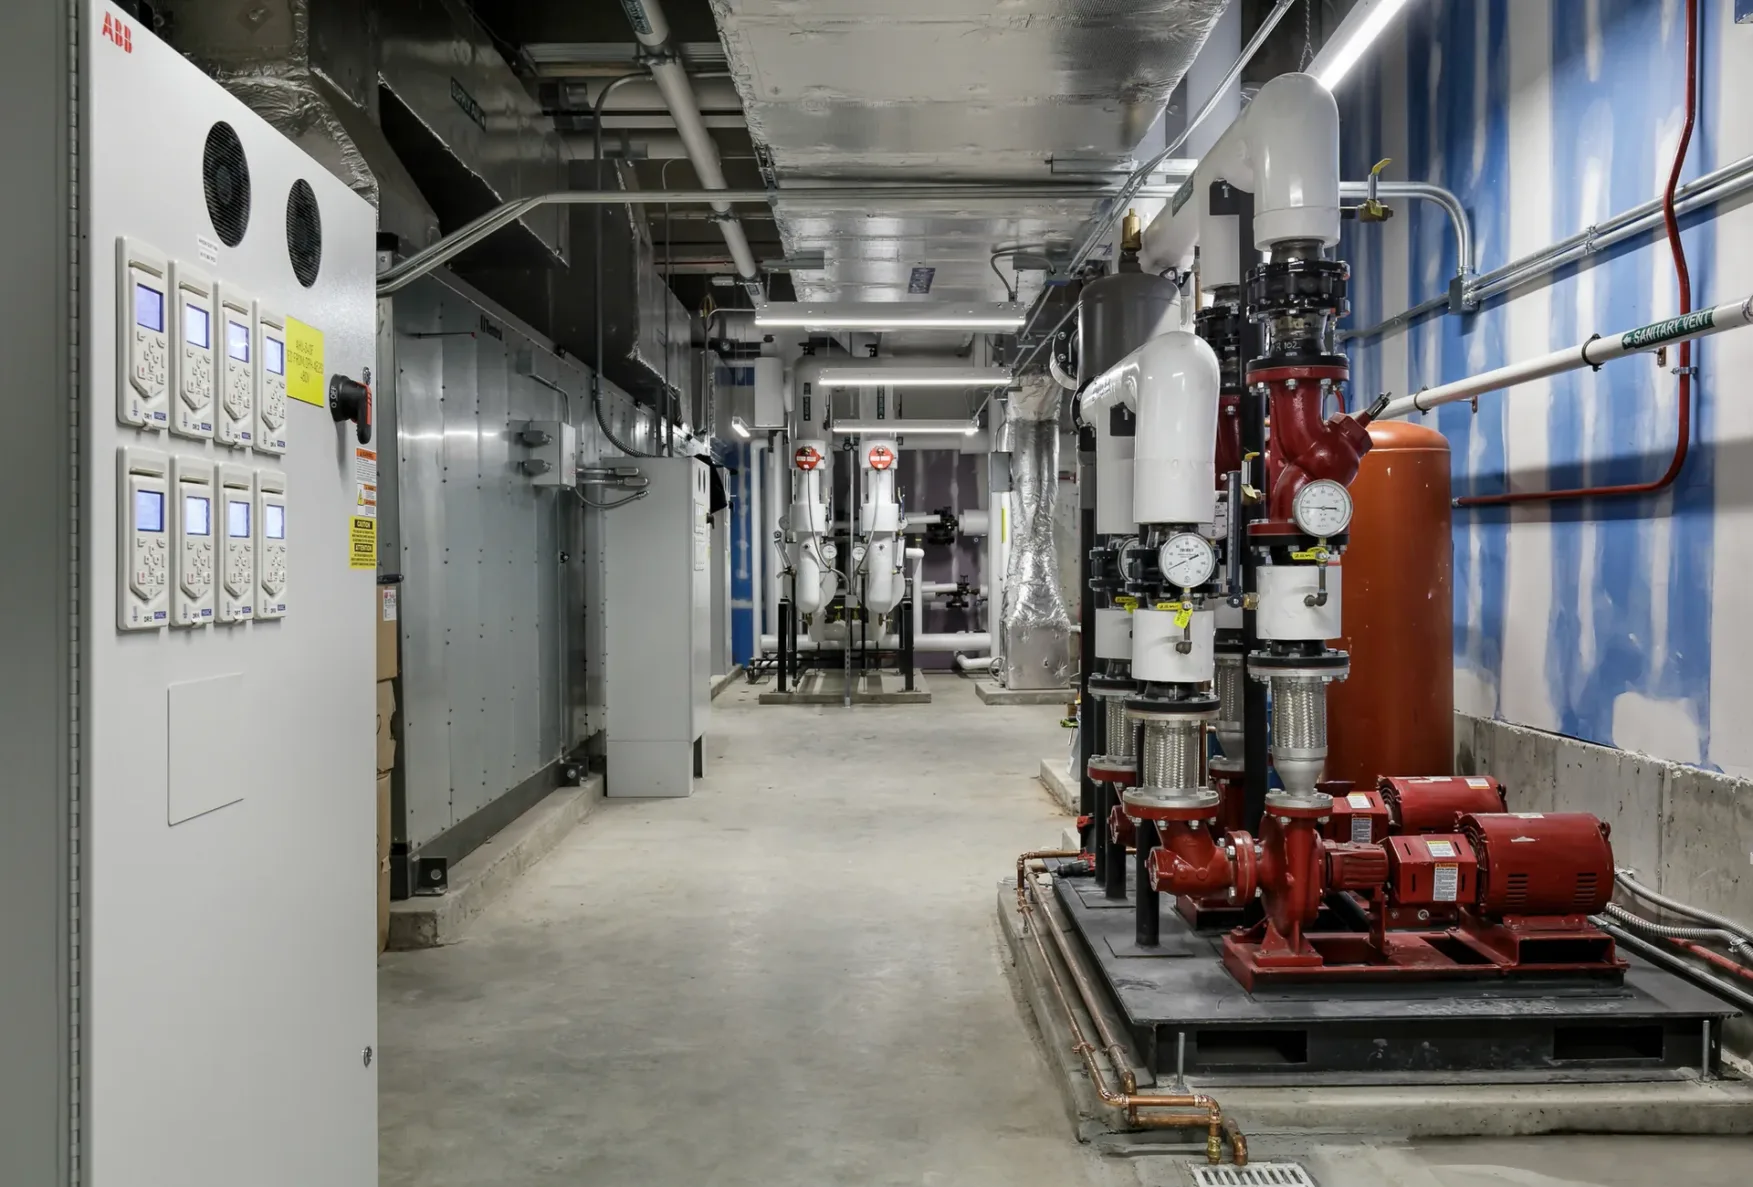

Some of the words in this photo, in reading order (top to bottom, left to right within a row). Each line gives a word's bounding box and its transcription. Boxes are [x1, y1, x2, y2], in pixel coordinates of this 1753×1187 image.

[102, 10, 133, 54] ABB
[1633, 317, 1682, 345] SANITARY
[1683, 309, 1714, 330] VENT
[1284, 341, 1301, 349] 102
[330, 385, 338, 400] OFF
[357, 520, 370, 528] CAUTION
[355, 544, 372, 552] ATTENTION
